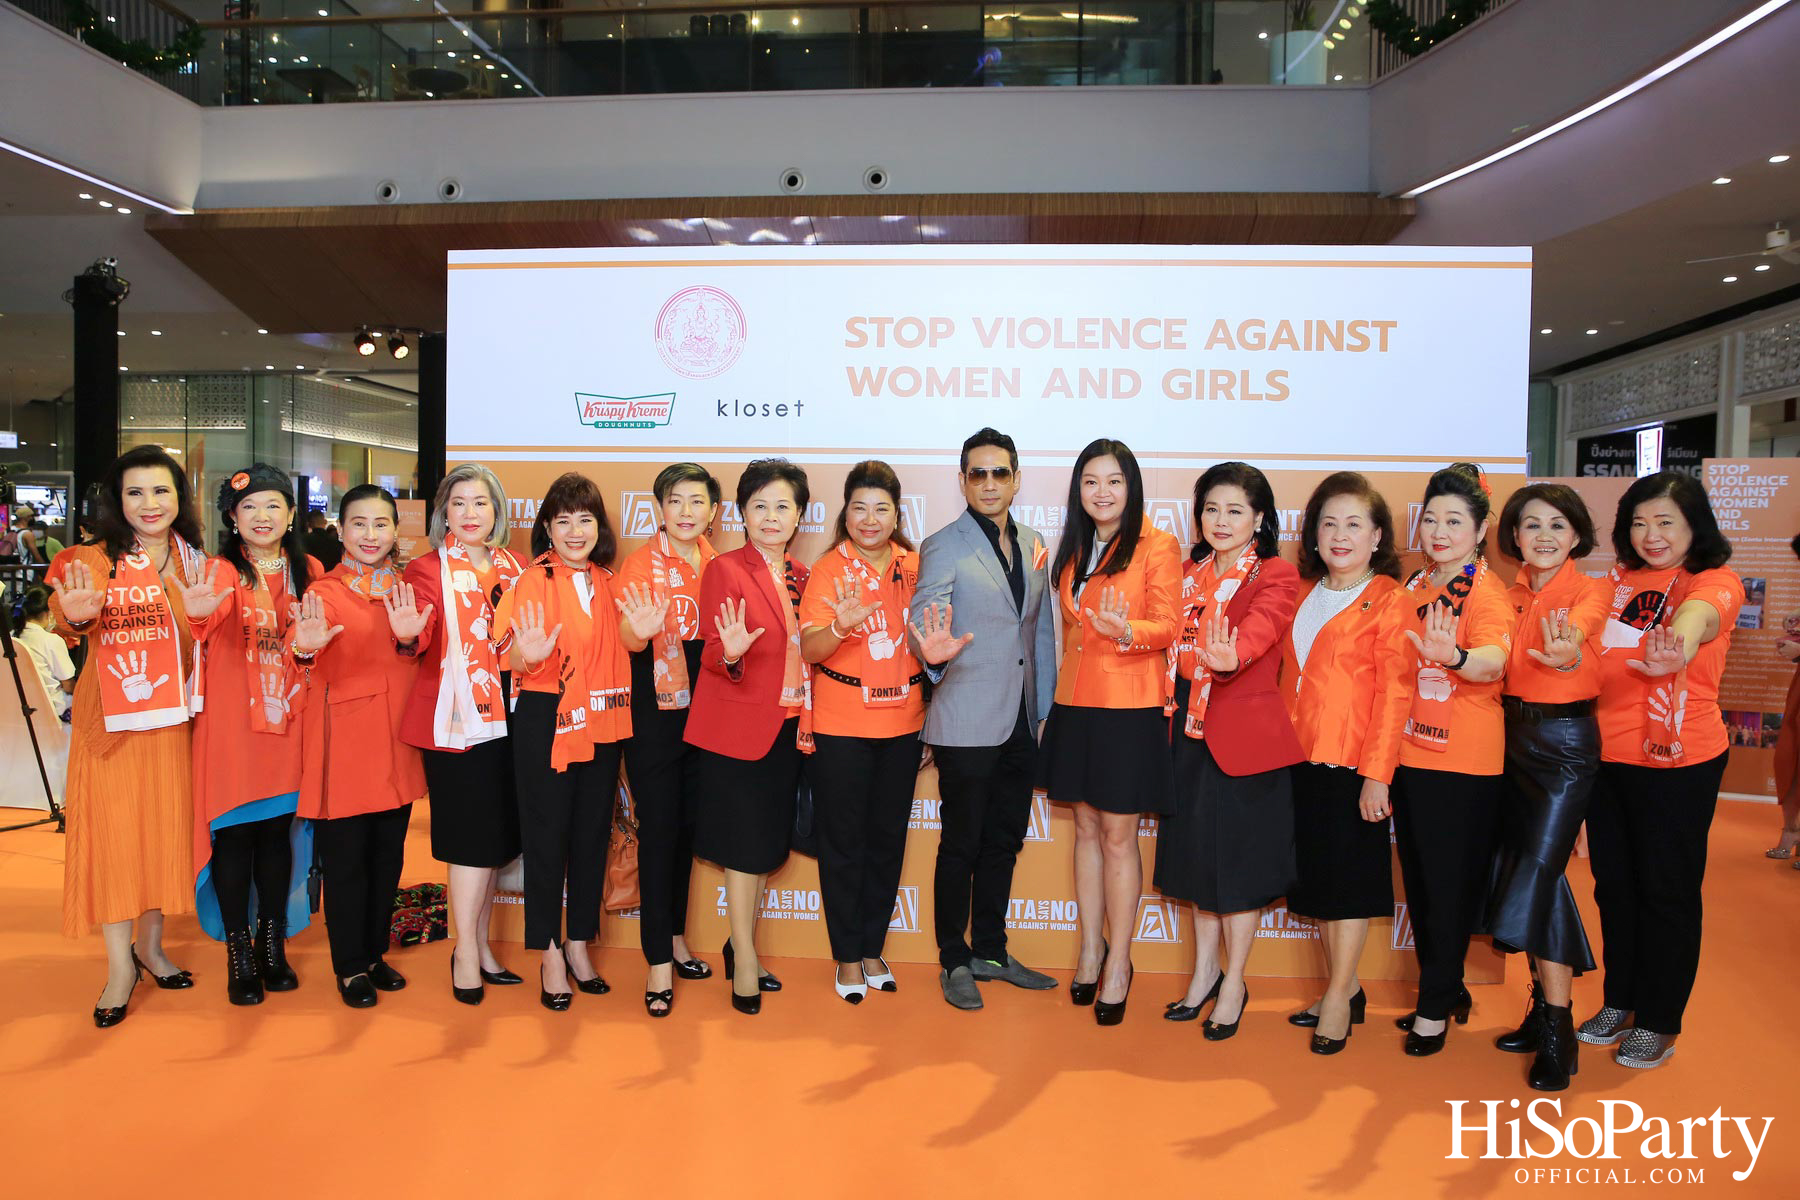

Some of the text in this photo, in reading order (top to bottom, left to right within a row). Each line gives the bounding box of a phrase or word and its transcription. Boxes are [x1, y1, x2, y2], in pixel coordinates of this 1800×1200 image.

[845, 316, 1397, 353] STOP VIOLENCE AGAINST
[846, 366, 1290, 402] WOMEN AND GIRLS
[583, 401, 669, 420] Krispy Kreme
[717, 399, 804, 417] kloset
[1708, 464, 1750, 475] STOP
[1708, 475, 1789, 486] VIOLENCE
[1708, 486, 1779, 497] AGAINST
[1708, 497, 1769, 508] WOMEN
[1008, 505, 1046, 526] NTA
[1047, 506, 1058, 526] SAYS
[722, 524, 731, 532] TO
[1718, 520, 1750, 530] IRLS
[101, 626, 169, 646] WOMEN
[871, 688, 898, 698] ZONTA
[571, 706, 586, 725] NO
[1414, 722, 1445, 739] ZONTA
[1651, 743, 1671, 756] ZON
[911, 799, 921, 818] SAYS
[781, 890, 793, 910] SAYS
[793, 890, 820, 911] NO
[717, 909, 820, 920] TO AGAINST WOMEN
[1038, 900, 1049, 920] SAYS
[1050, 900, 1078, 921] NO
[1261, 908, 1300, 928] NTA
[1018, 921, 1049, 930] AGAINST
[1050, 922, 1077, 931] WOMEN
[1255, 930, 1279, 938] LENCE
[1281, 930, 1312, 938] AGAINST
